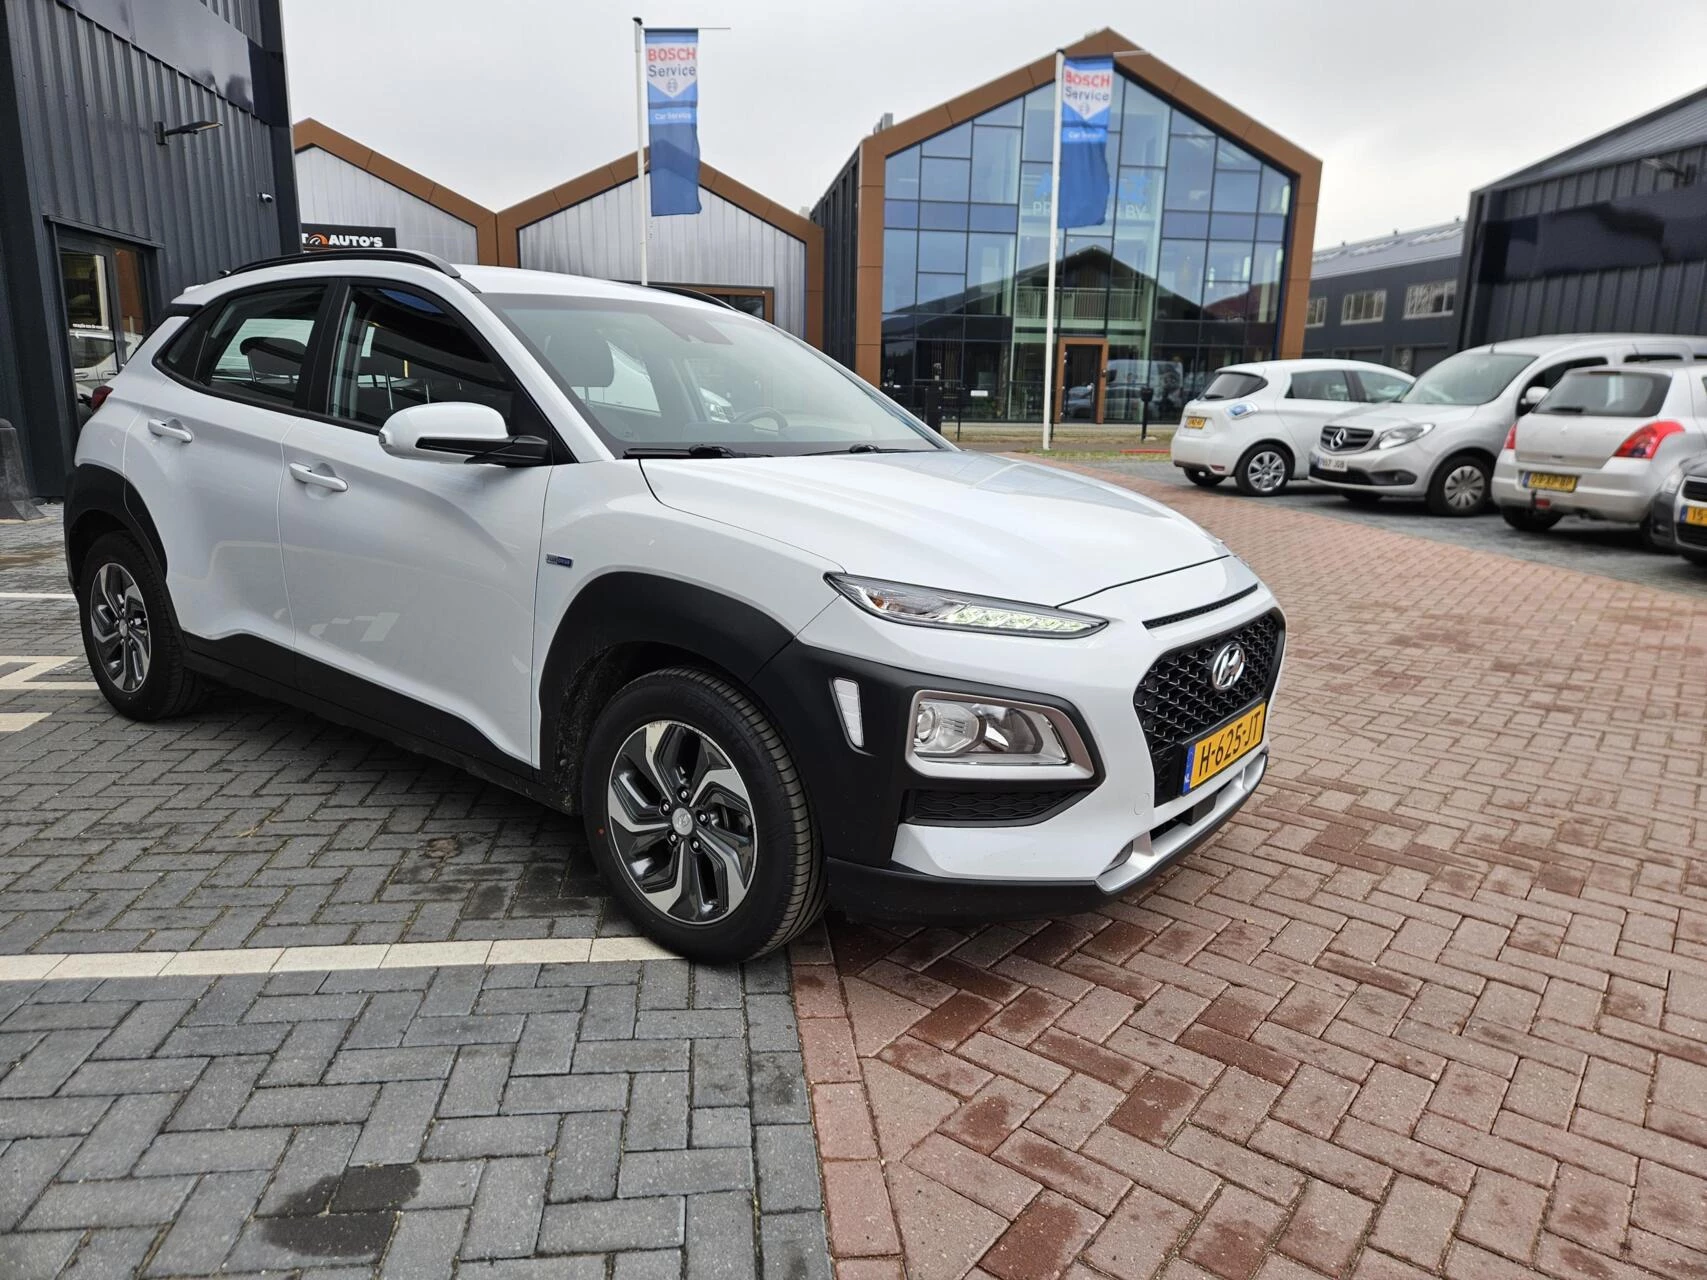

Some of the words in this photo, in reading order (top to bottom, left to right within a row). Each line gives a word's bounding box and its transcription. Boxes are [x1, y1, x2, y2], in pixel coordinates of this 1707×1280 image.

[648, 47, 696, 61] BOSCH
[648, 64, 696, 77] Service
[1065, 70, 1110, 87] BOSCH
[1065, 85, 1109, 101] Service
[329, 235, 383, 247] AUTO'S
[1198, 710, 1261, 777] H-625-JT
